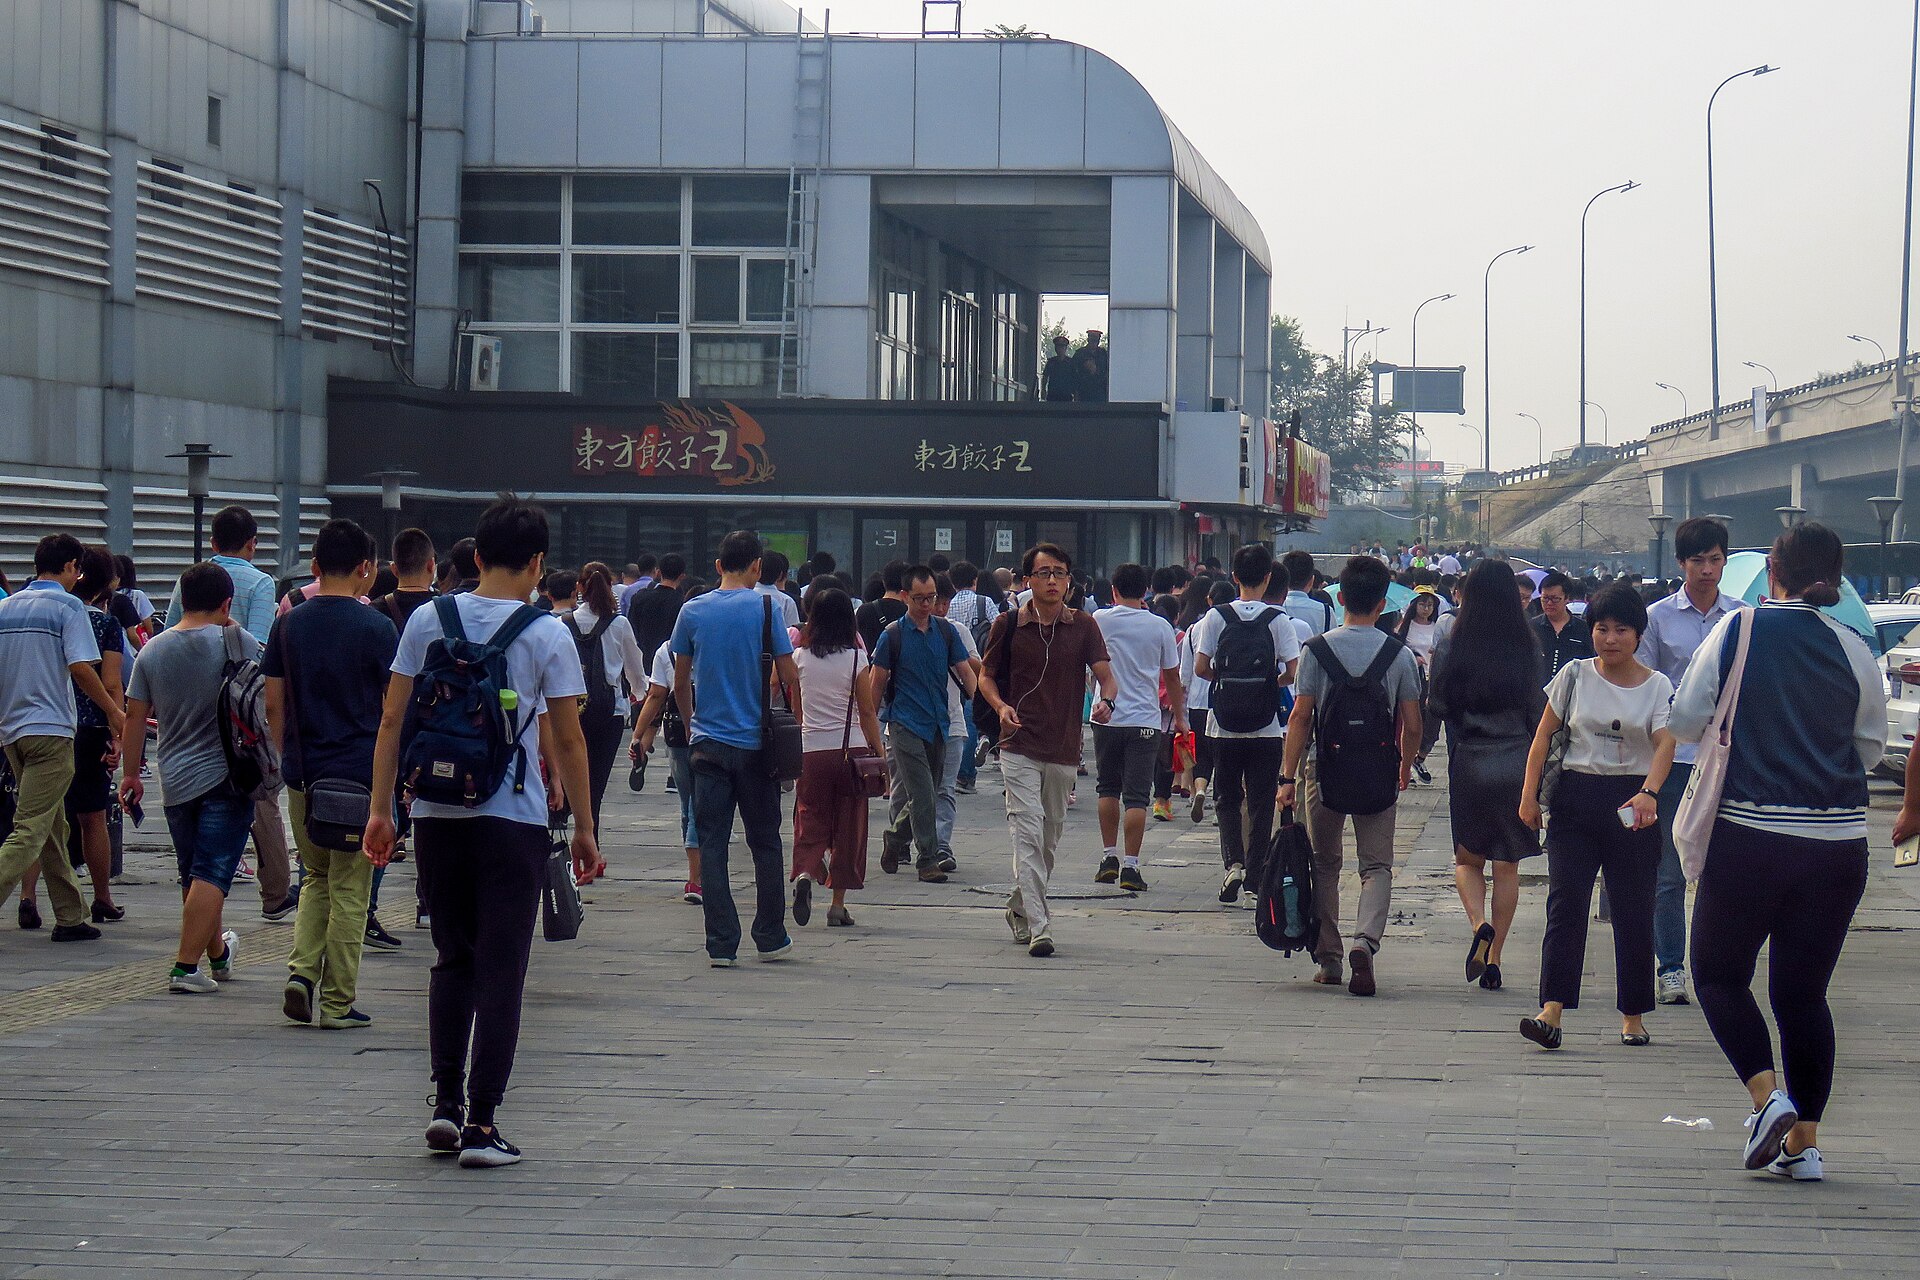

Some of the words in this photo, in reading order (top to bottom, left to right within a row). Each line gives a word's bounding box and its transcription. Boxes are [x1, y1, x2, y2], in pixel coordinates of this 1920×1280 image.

[576, 427, 733, 471] 東方餃子王
[914, 439, 1033, 472] 東方餃子王
